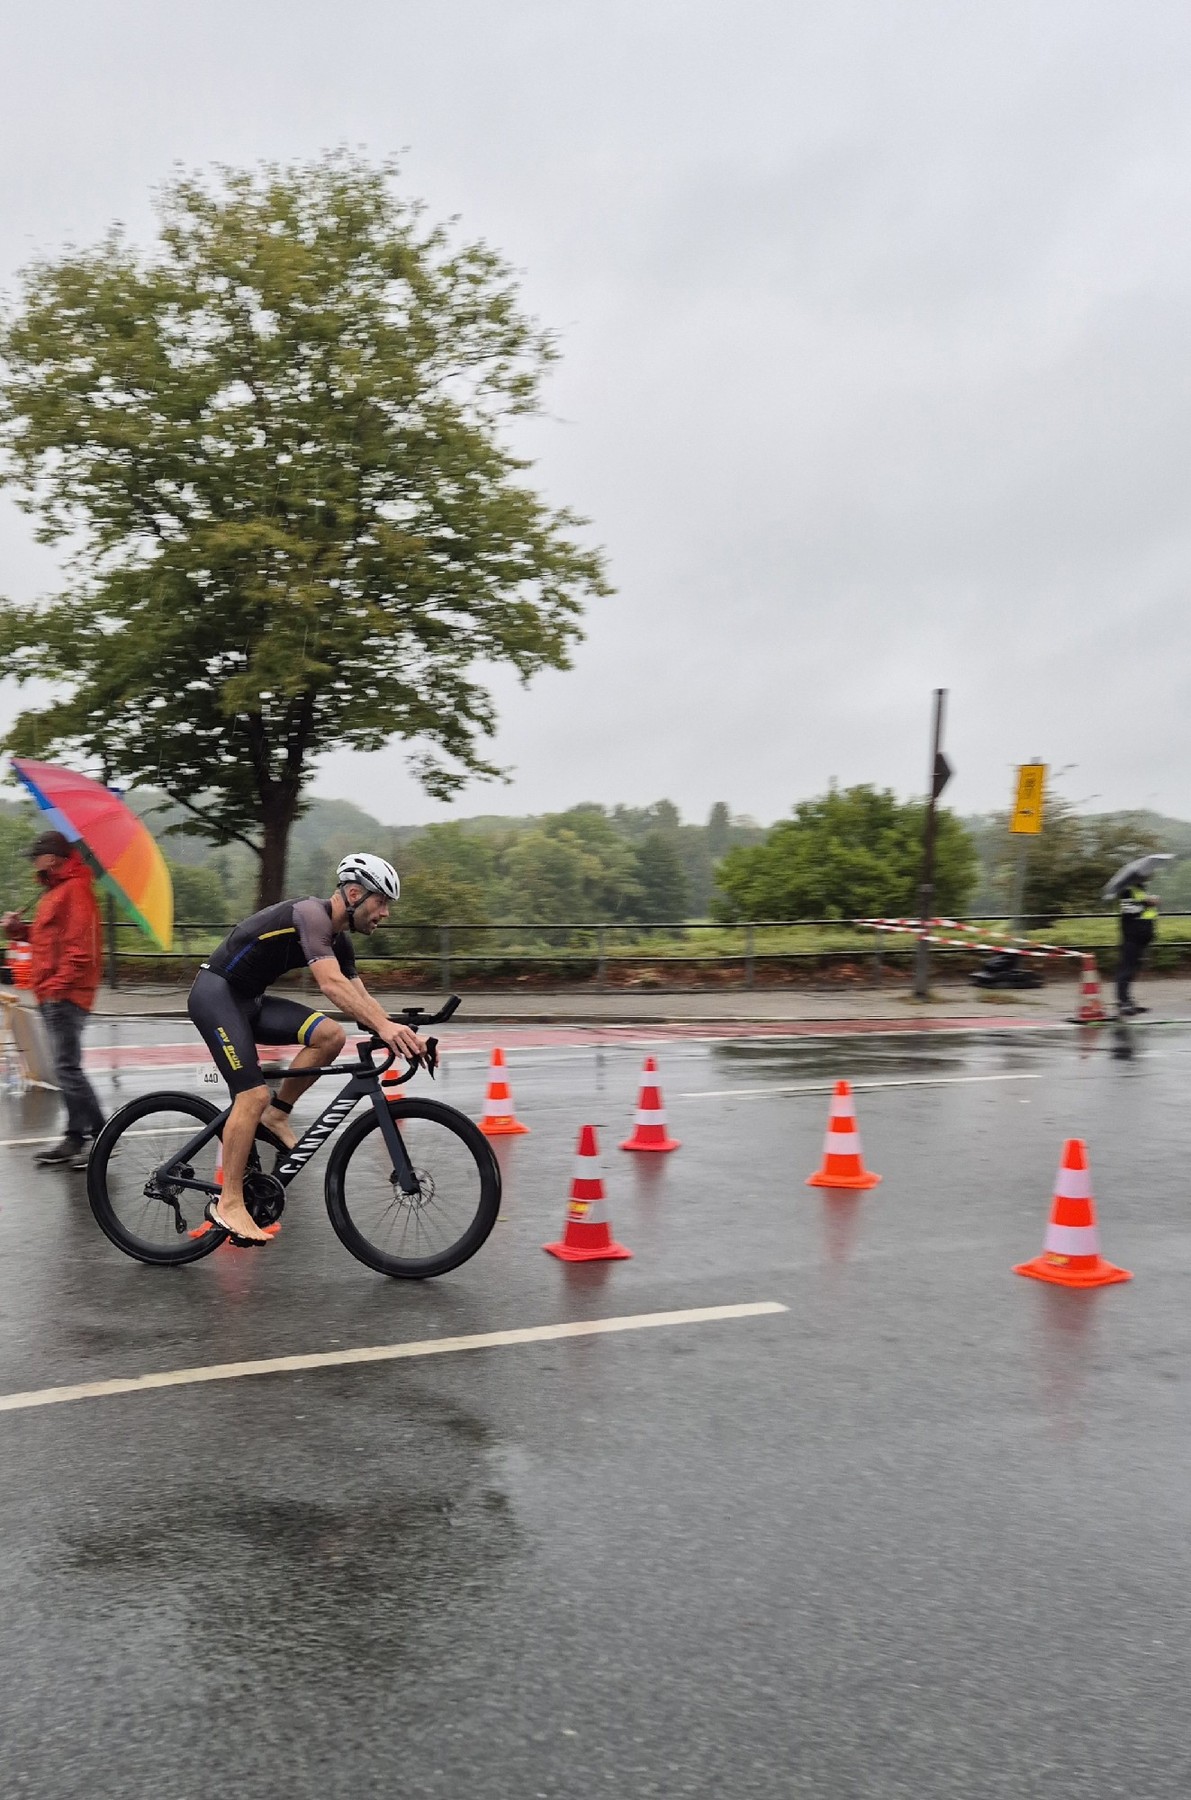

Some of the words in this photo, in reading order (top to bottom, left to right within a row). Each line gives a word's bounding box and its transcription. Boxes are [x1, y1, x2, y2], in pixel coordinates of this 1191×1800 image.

[217, 1026, 230, 1043] PSV
[203, 1073, 219, 1084] 440
[279, 1099, 358, 1174] CANYON
